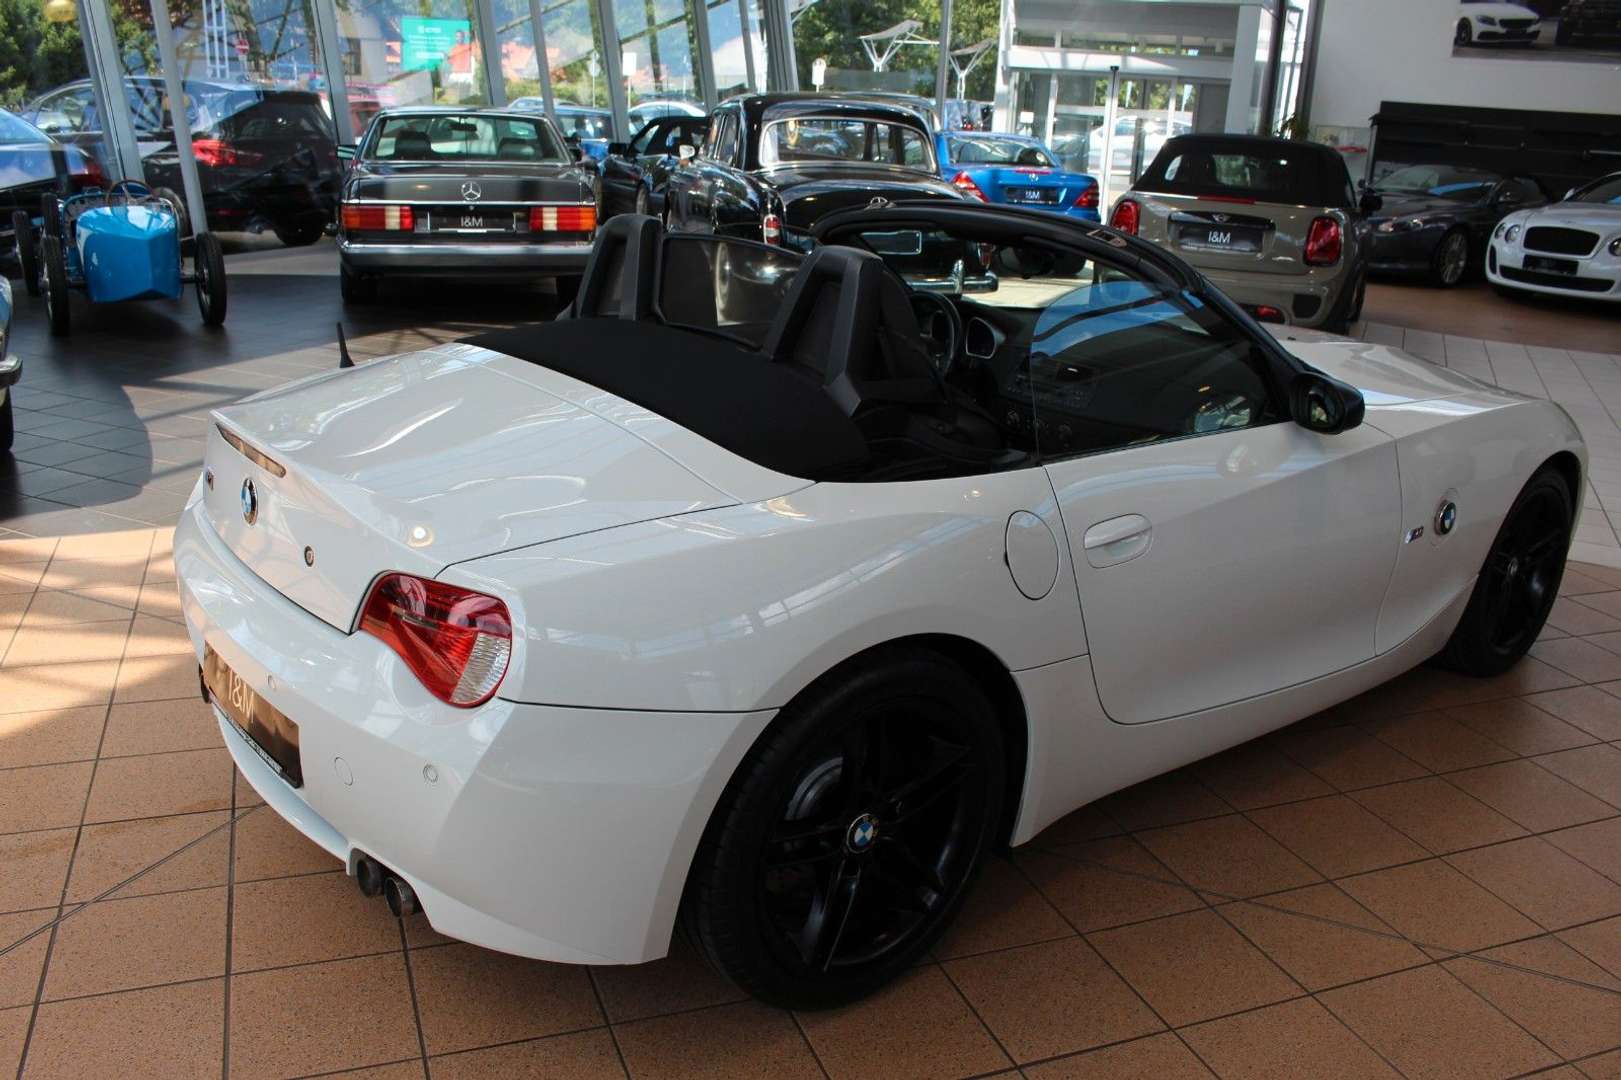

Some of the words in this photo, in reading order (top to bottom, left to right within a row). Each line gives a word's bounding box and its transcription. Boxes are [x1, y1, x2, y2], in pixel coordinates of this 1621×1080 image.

[461, 216, 483, 227] I&M
[1208, 231, 1231, 243] I&M
[228, 667, 254, 723] I&M
